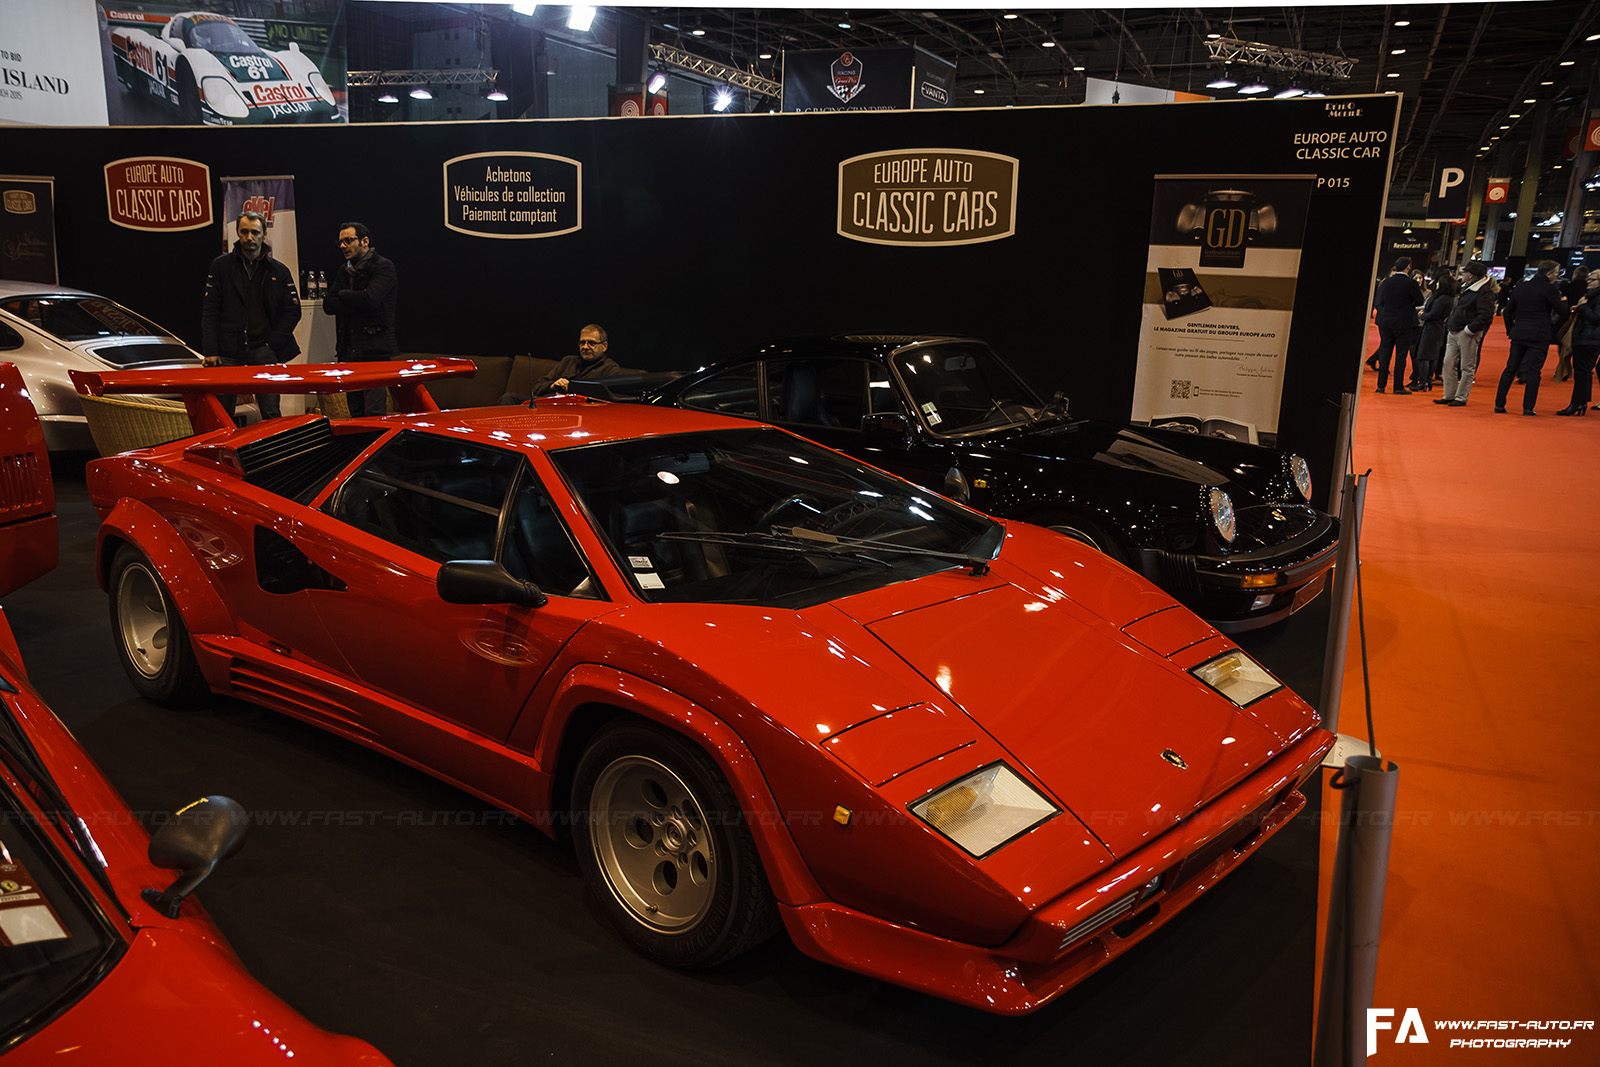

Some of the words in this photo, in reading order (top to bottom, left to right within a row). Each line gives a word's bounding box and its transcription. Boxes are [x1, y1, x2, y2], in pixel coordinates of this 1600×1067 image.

[110, 11, 145, 21] Castrol
[155, 50, 169, 87] 61
[229, 55, 274, 69] Castrol
[2, 67, 69, 95] ISLAND
[247, 66, 270, 80] 61
[253, 82, 307, 102] Castrol
[268, 102, 312, 119] JAGUAR
[1294, 132, 1346, 144] EUROPE
[1349, 131, 1387, 143] AUTO
[1296, 147, 1350, 159] CLASSIC
[1353, 147, 1380, 158] CAR
[125, 164, 158, 183] EUROPE
[160, 164, 184, 183] AUTO
[486, 166, 531, 182] Achetons
[874, 158, 929, 183] EUROPE
[933, 158, 973, 183] AUTO
[1317, 177, 1325, 188] P
[1327, 177, 1350, 188] 015
[1438, 167, 1465, 198] P
[454, 185, 499, 202] Véhicules
[502, 186, 514, 202] de
[516, 186, 566, 202] collection
[116, 189, 166, 222] CLASSIC
[169, 189, 202, 222] CARS
[462, 204, 507, 222] Paiement
[509, 209, 557, 226] comptant
[853, 191, 935, 234] CLASSIC
[943, 191, 998, 233] CARS
[1207, 208, 1246, 248] GD
